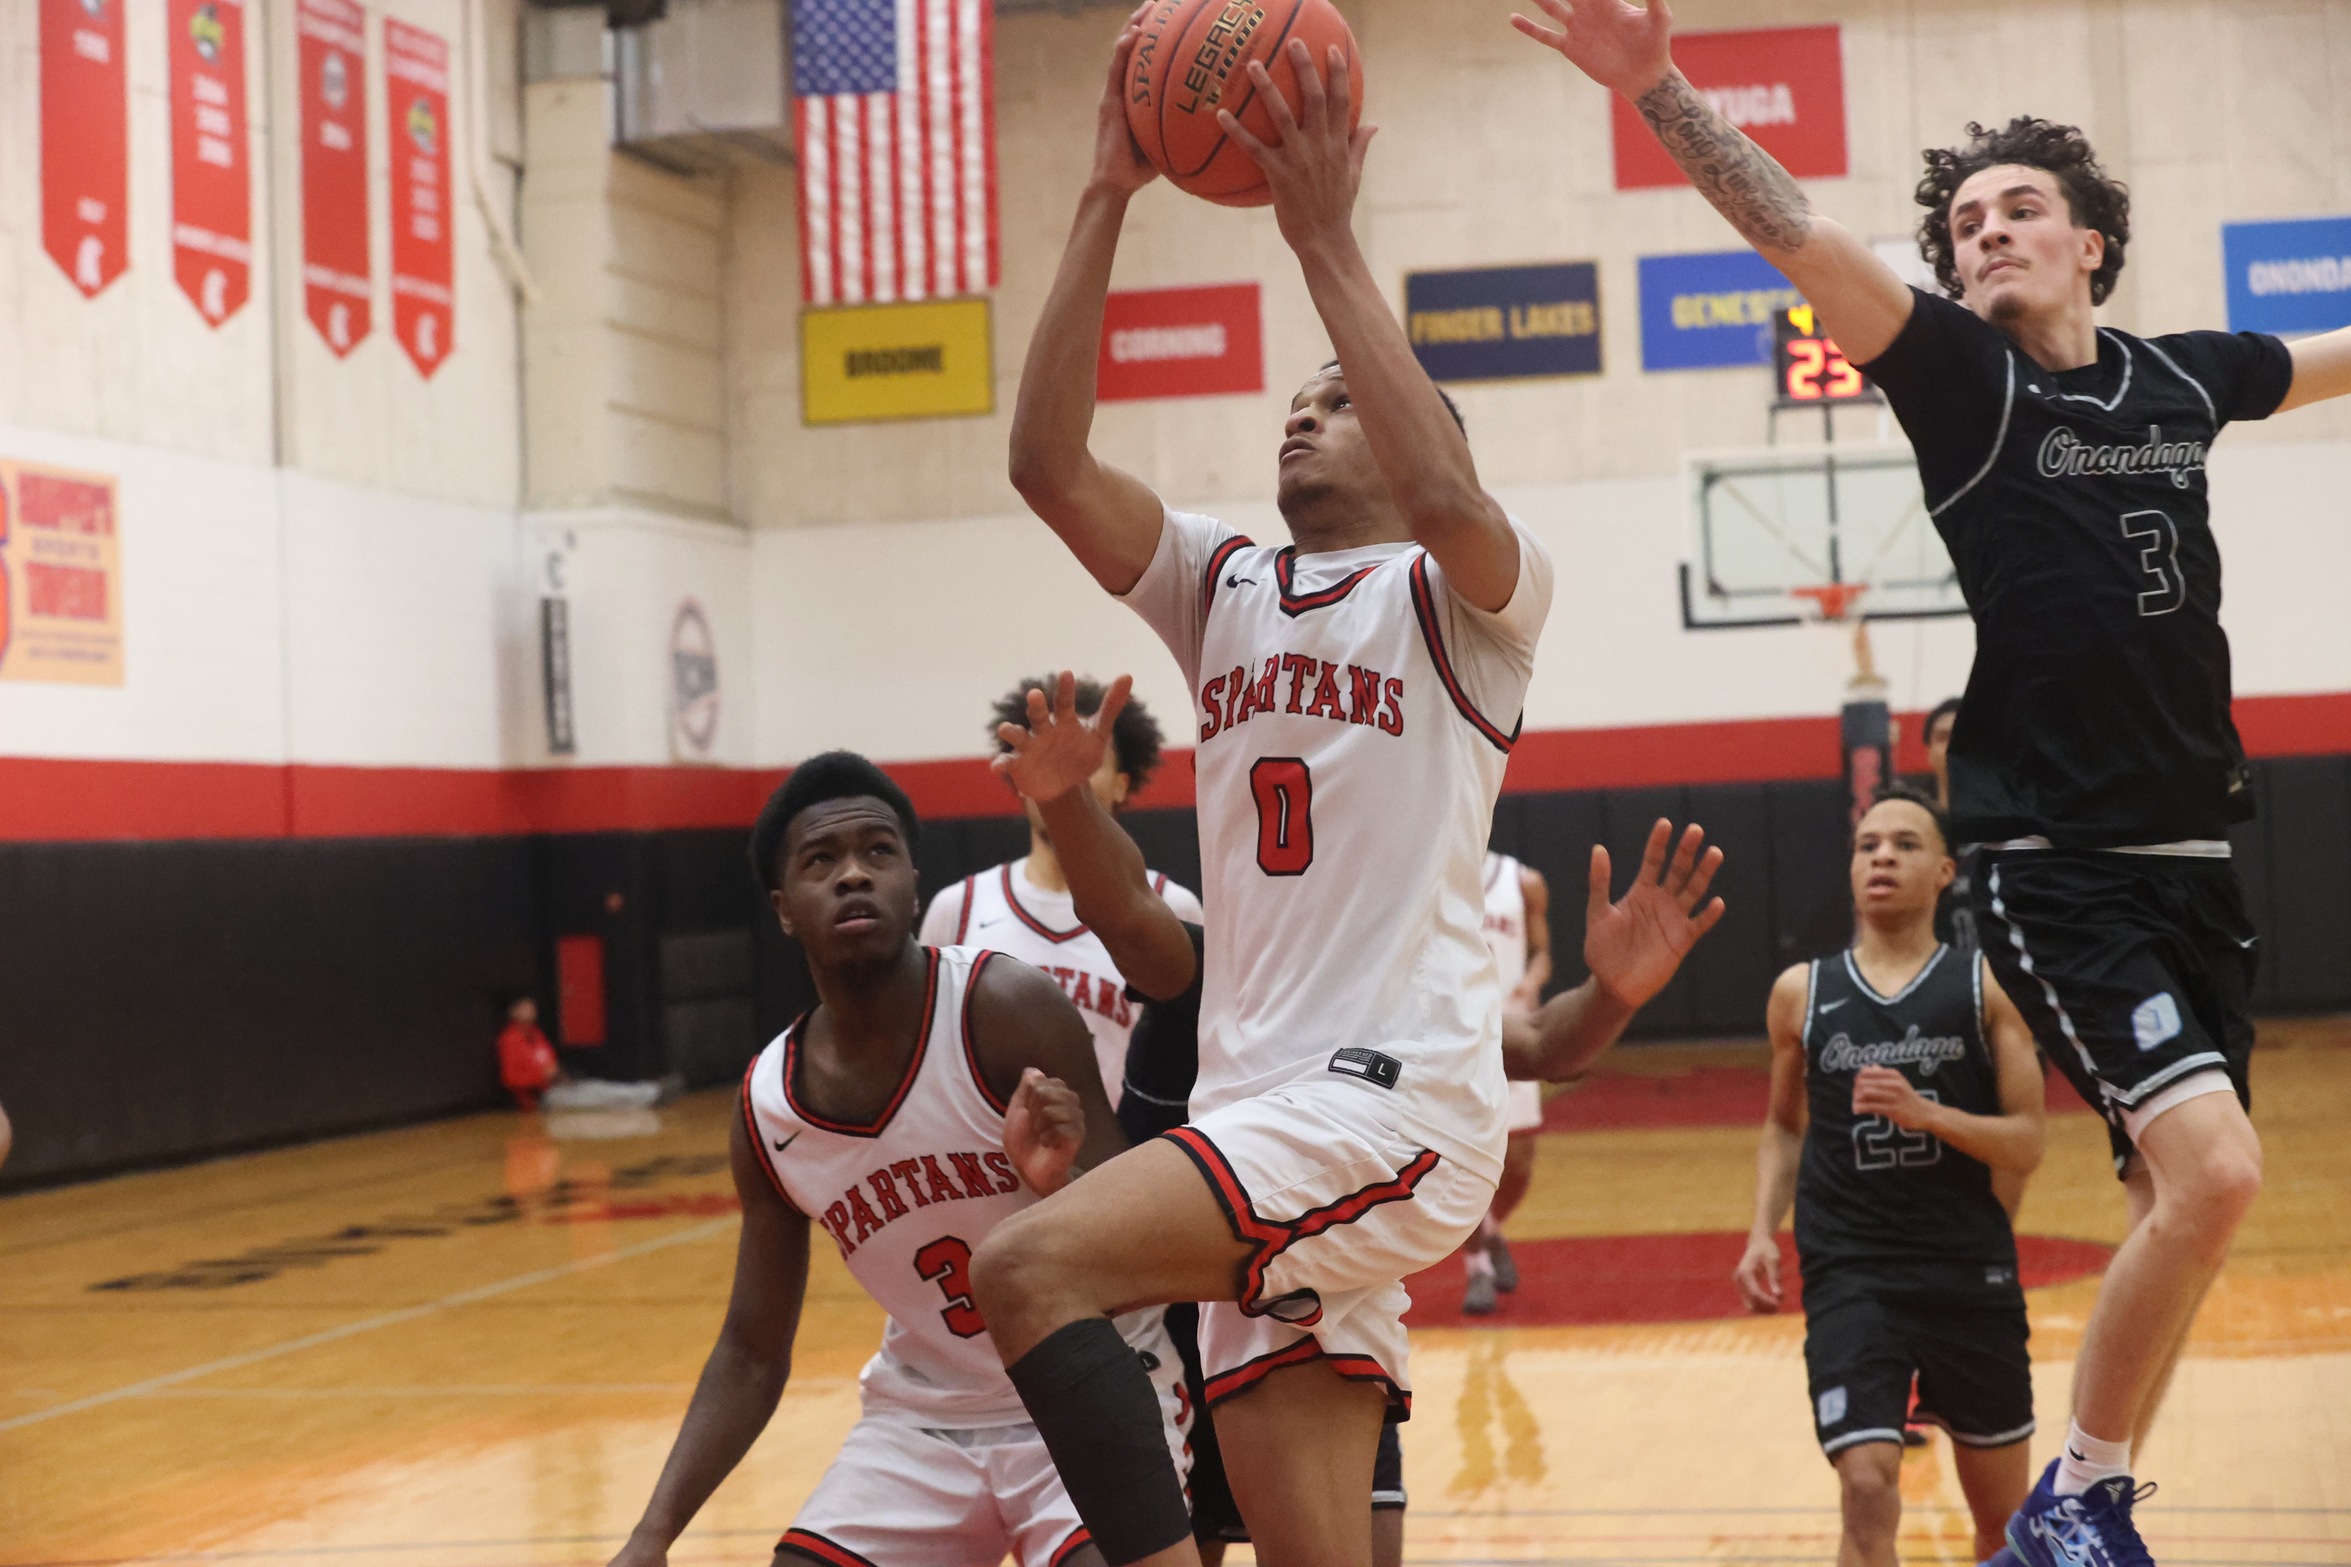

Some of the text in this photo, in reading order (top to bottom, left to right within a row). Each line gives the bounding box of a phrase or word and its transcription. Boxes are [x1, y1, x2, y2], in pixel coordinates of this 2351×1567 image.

[1699, 84, 1797, 127] YUGA
[1410, 301, 1595, 345] FINGER LAKES
[2119, 509, 2186, 617] 3
[1200, 652, 1404, 743] SPARTANS
[1249, 756, 1314, 876] 0
[1377, 1062, 1386, 1076] L
[1819, 1024, 1966, 1077] Onondaga
[913, 1235, 987, 1339] 3
